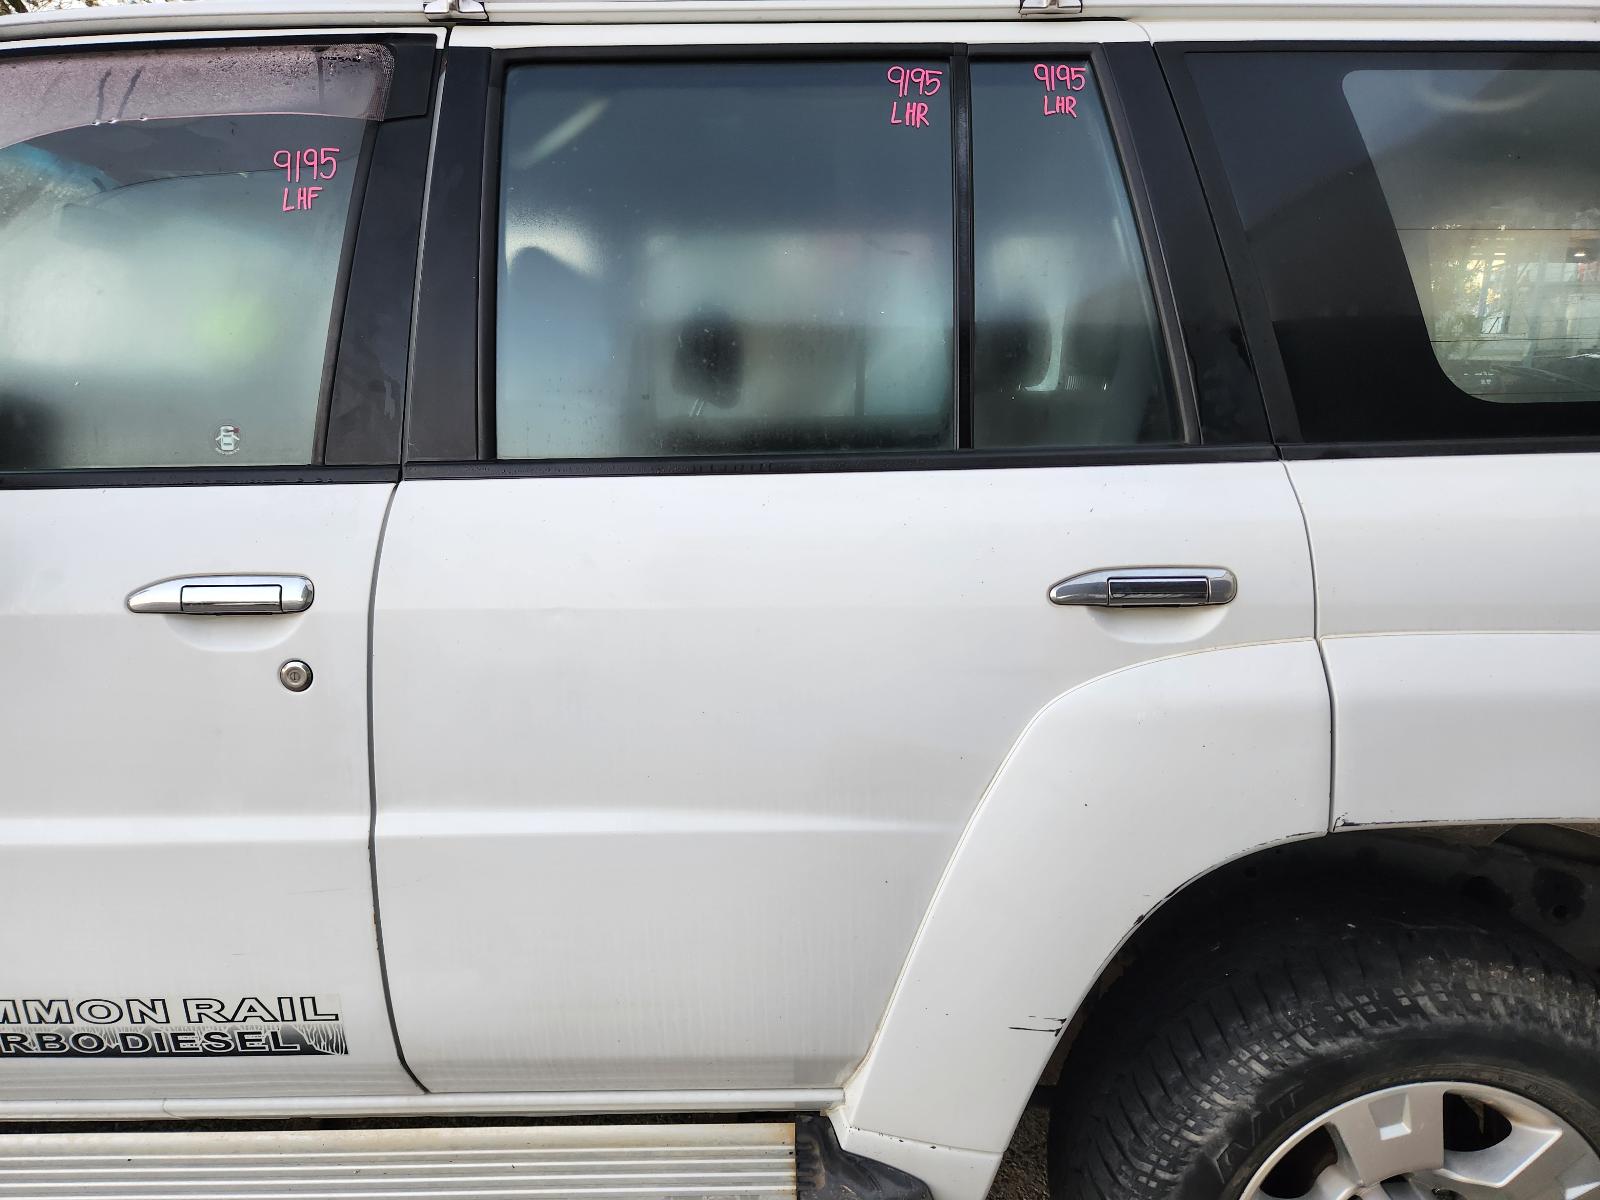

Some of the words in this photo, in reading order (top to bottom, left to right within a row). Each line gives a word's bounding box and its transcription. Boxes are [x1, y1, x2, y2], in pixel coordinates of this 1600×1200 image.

[887, 66, 943, 97] 9195
[1033, 63, 1087, 92] 9195
[890, 101, 930, 128] LHR
[1043, 95, 1077, 118] LHR
[273, 147, 340, 182] 9195
[282, 186, 322, 212] LHF
[182, 996, 339, 1023] RAIL
[119, 1030, 300, 1053] DIESEL
